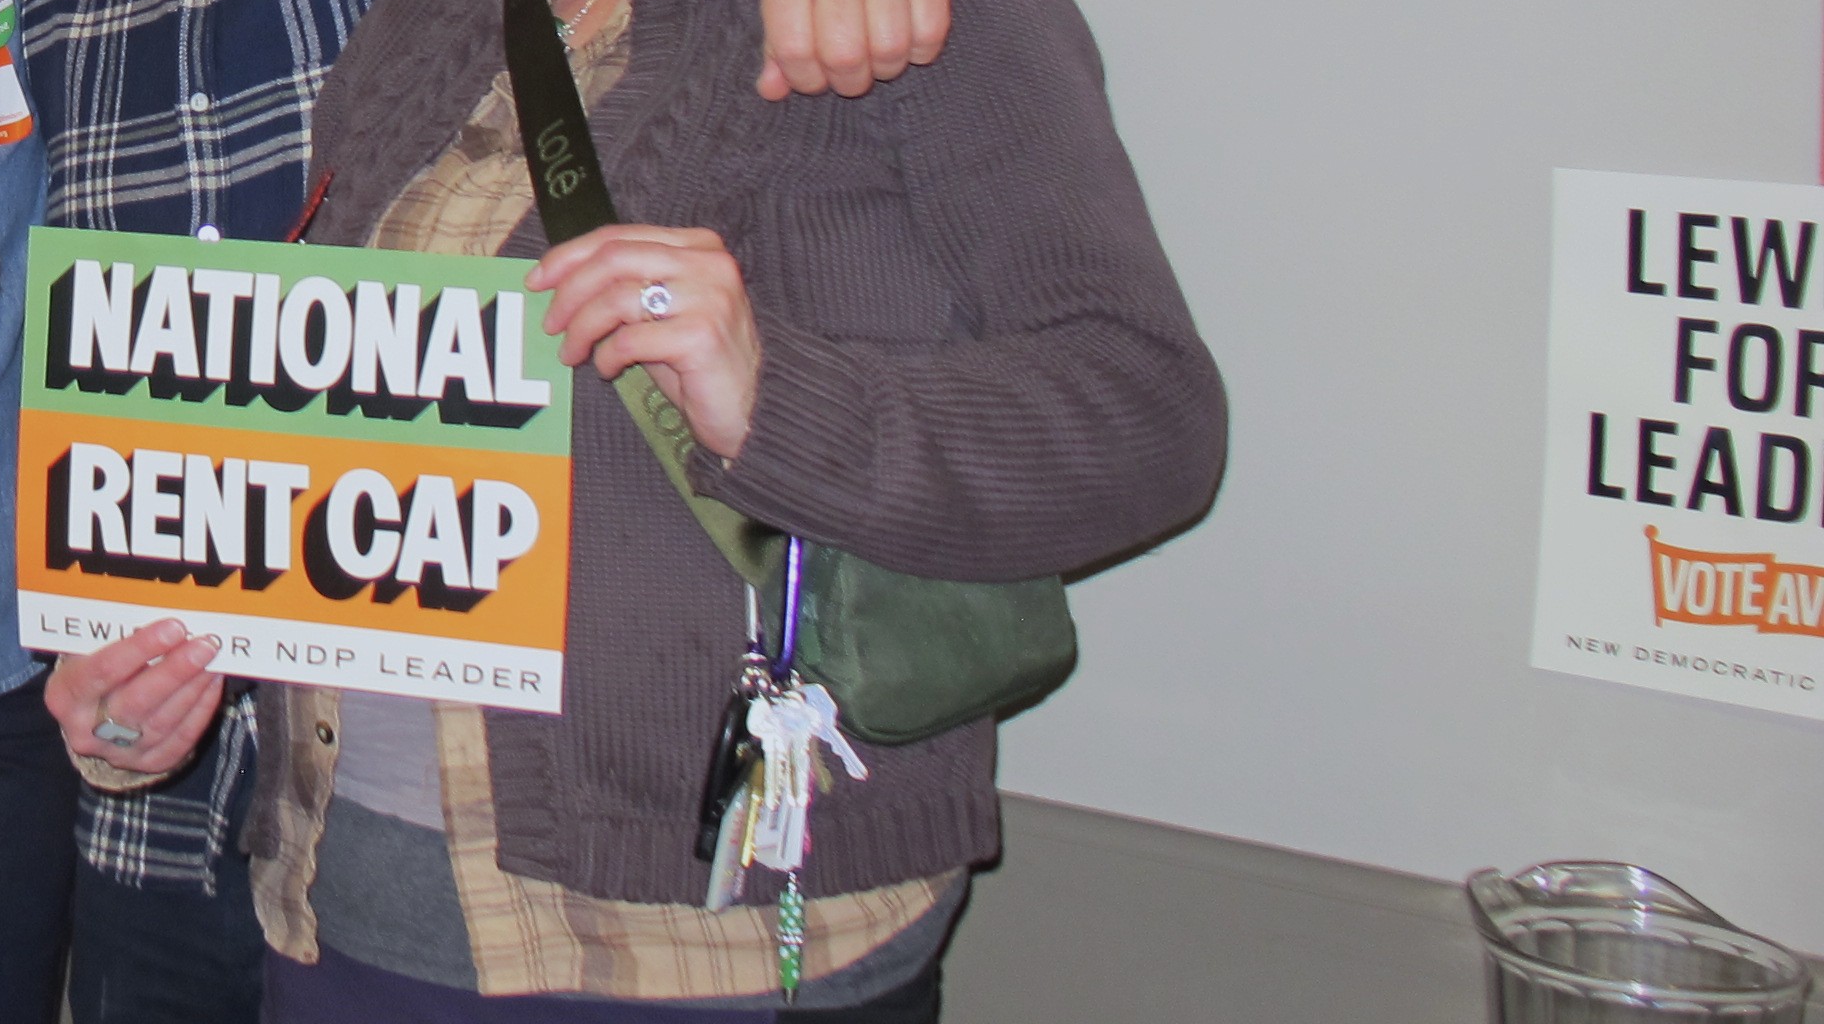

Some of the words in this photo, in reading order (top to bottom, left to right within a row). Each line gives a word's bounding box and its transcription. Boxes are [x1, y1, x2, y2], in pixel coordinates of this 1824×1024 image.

[1626, 208, 1824, 309] LEW
[69, 258, 552, 407] NATIONAL
[68, 442, 310, 571] RENT
[325, 467, 541, 592] CAP
[1586, 412, 1824, 530] LEAD
[1658, 552, 1767, 617] VOTE
[40, 613, 142, 641] LEWI
[277, 641, 357, 668] NDP
[379, 654, 543, 694] LEADER
[1565, 634, 1621, 658] NEW
[1633, 646, 1816, 692] DEMOCRATIC
